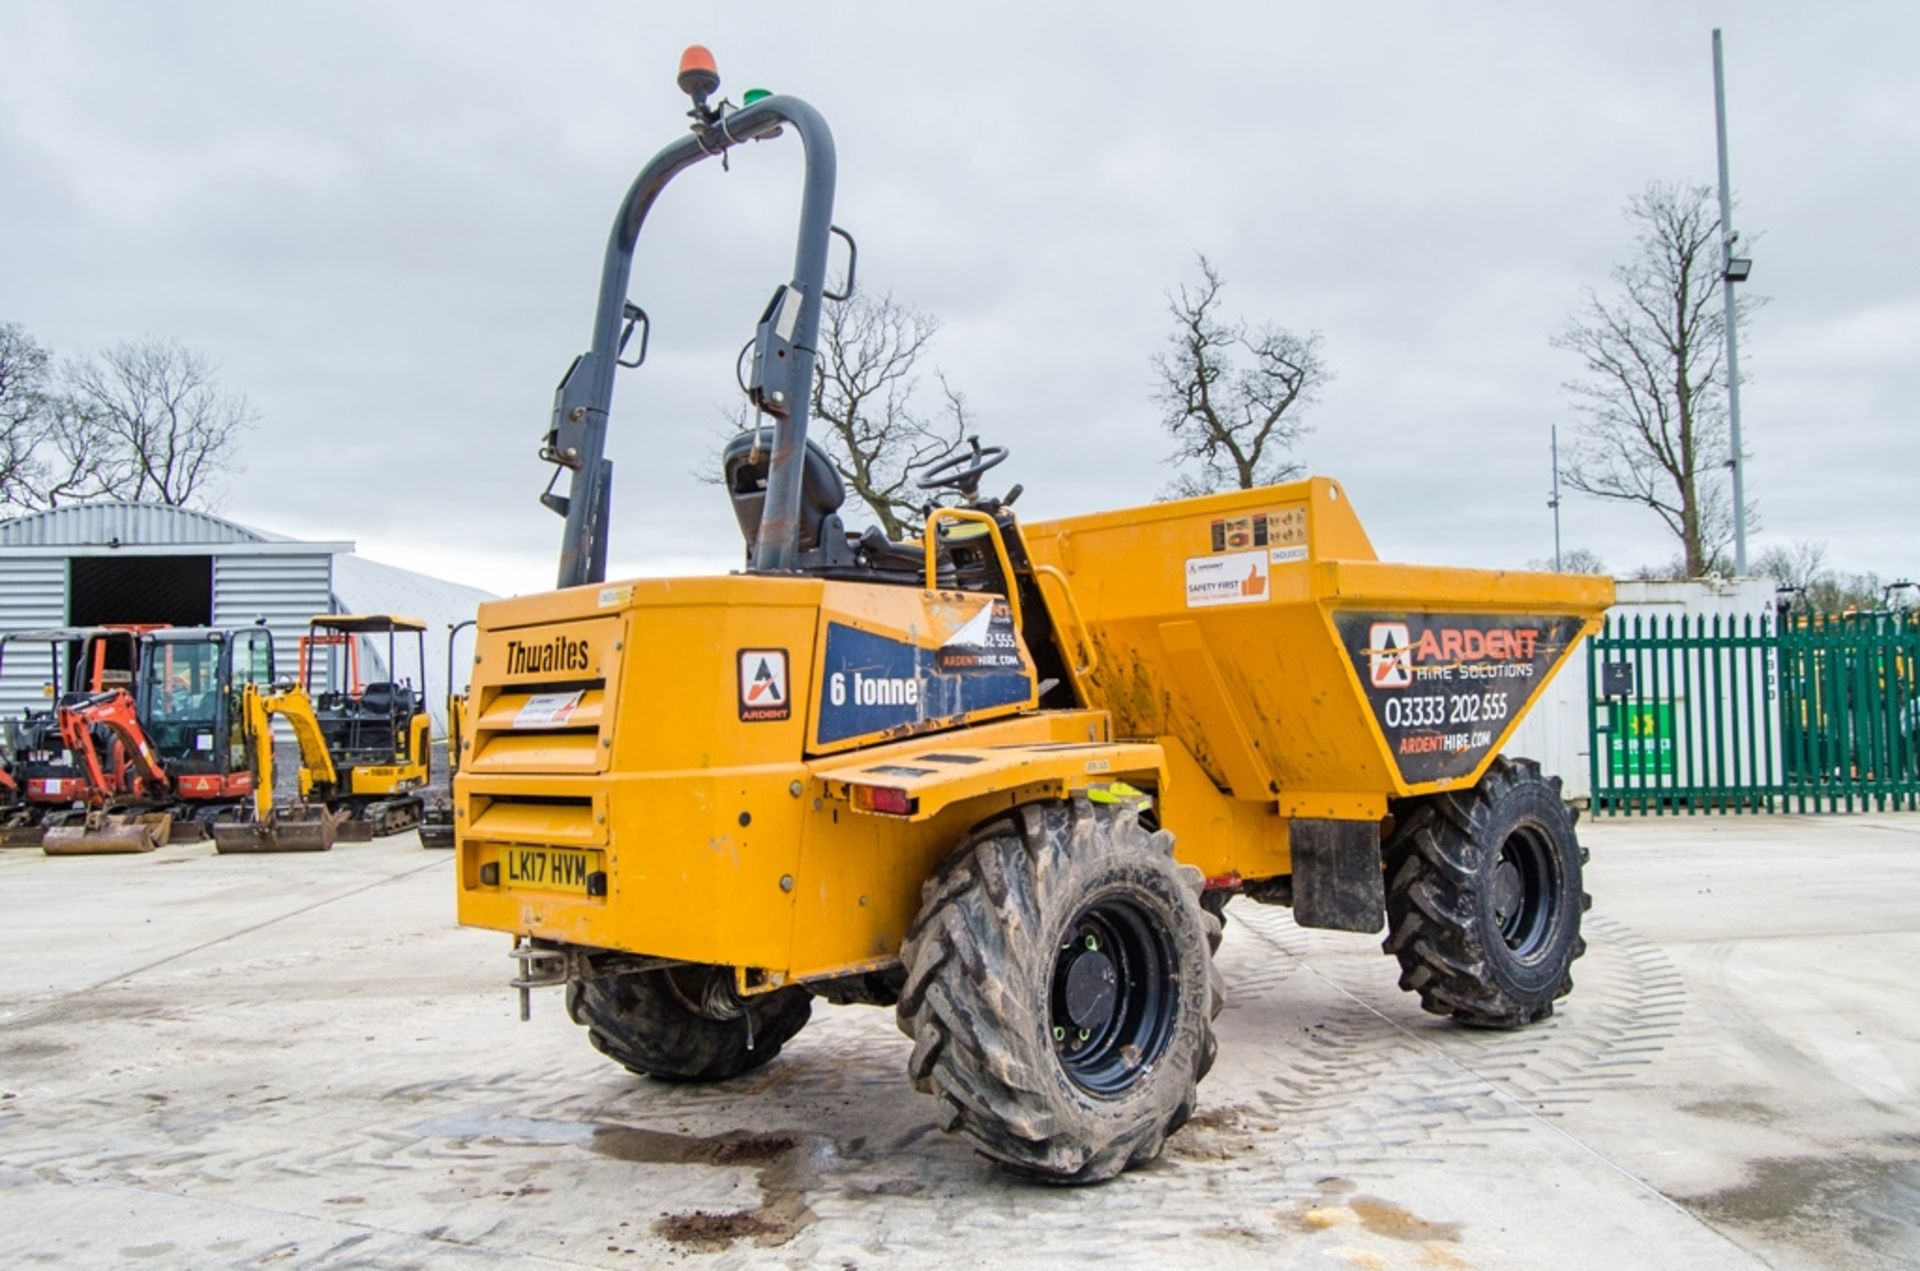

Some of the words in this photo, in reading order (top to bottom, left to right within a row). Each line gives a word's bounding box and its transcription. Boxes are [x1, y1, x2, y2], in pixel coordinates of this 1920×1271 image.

[1188, 581, 1217, 594] SAFETY
[1218, 580, 1239, 592] FIRST
[506, 635, 590, 675] Thwaites
[1416, 628, 1539, 661] ARDENT
[943, 654, 1019, 667] ARDENTHIRE.COM
[1416, 665, 1453, 681] HIRE
[1459, 663, 1534, 680] SOLUTIONS
[830, 674, 846, 707] 6
[855, 674, 917, 706] tonne
[741, 709, 789, 721] ARDENT
[1384, 696, 1445, 728] 03333
[1450, 694, 1480, 723] 202
[1482, 692, 1508, 720] 555
[1400, 731, 1491, 754] ARDENTHIRE.COM
[508, 850, 547, 883] LK17
[551, 852, 587, 886] HVM
